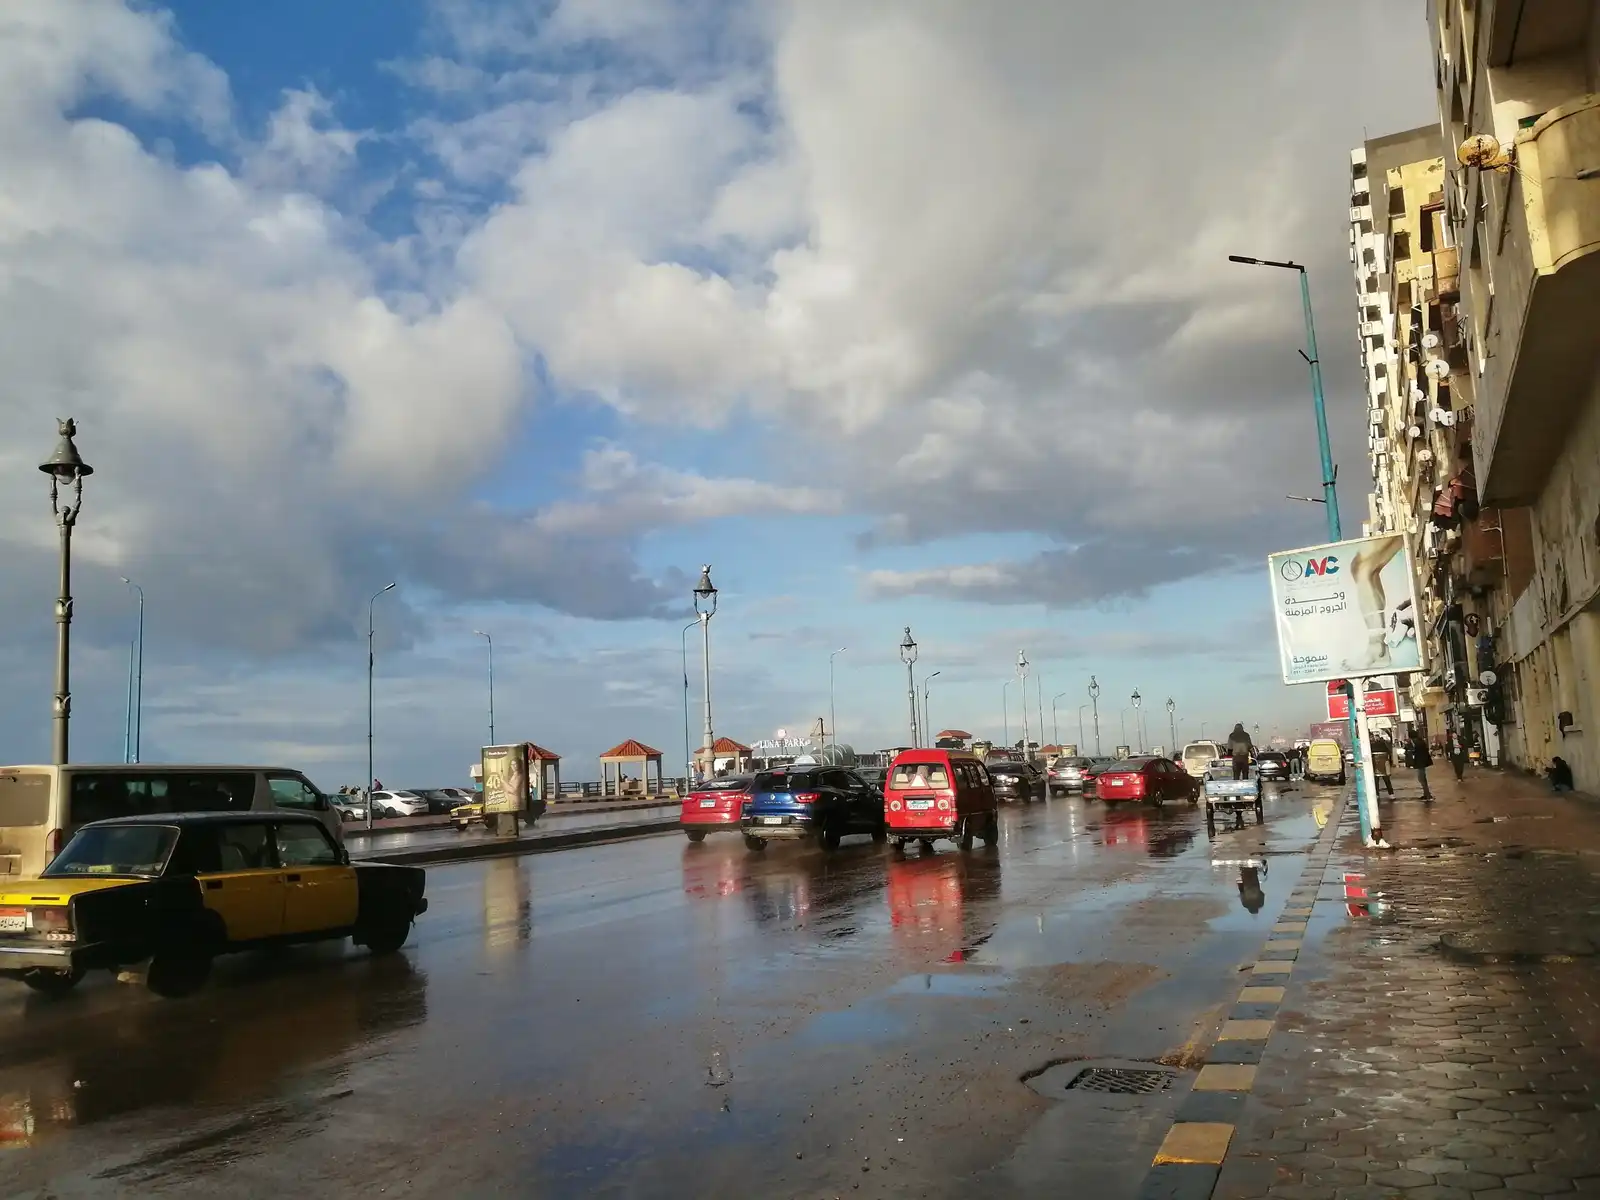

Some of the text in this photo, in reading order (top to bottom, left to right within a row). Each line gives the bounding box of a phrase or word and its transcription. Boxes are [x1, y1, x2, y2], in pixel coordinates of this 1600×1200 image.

[1305, 556, 1340, 577] AVC
[1285, 602, 1347, 617] الجروح المزمنة
[1292, 654, 1328, 664] سموحة
[784, 737, 805, 747] PARK
